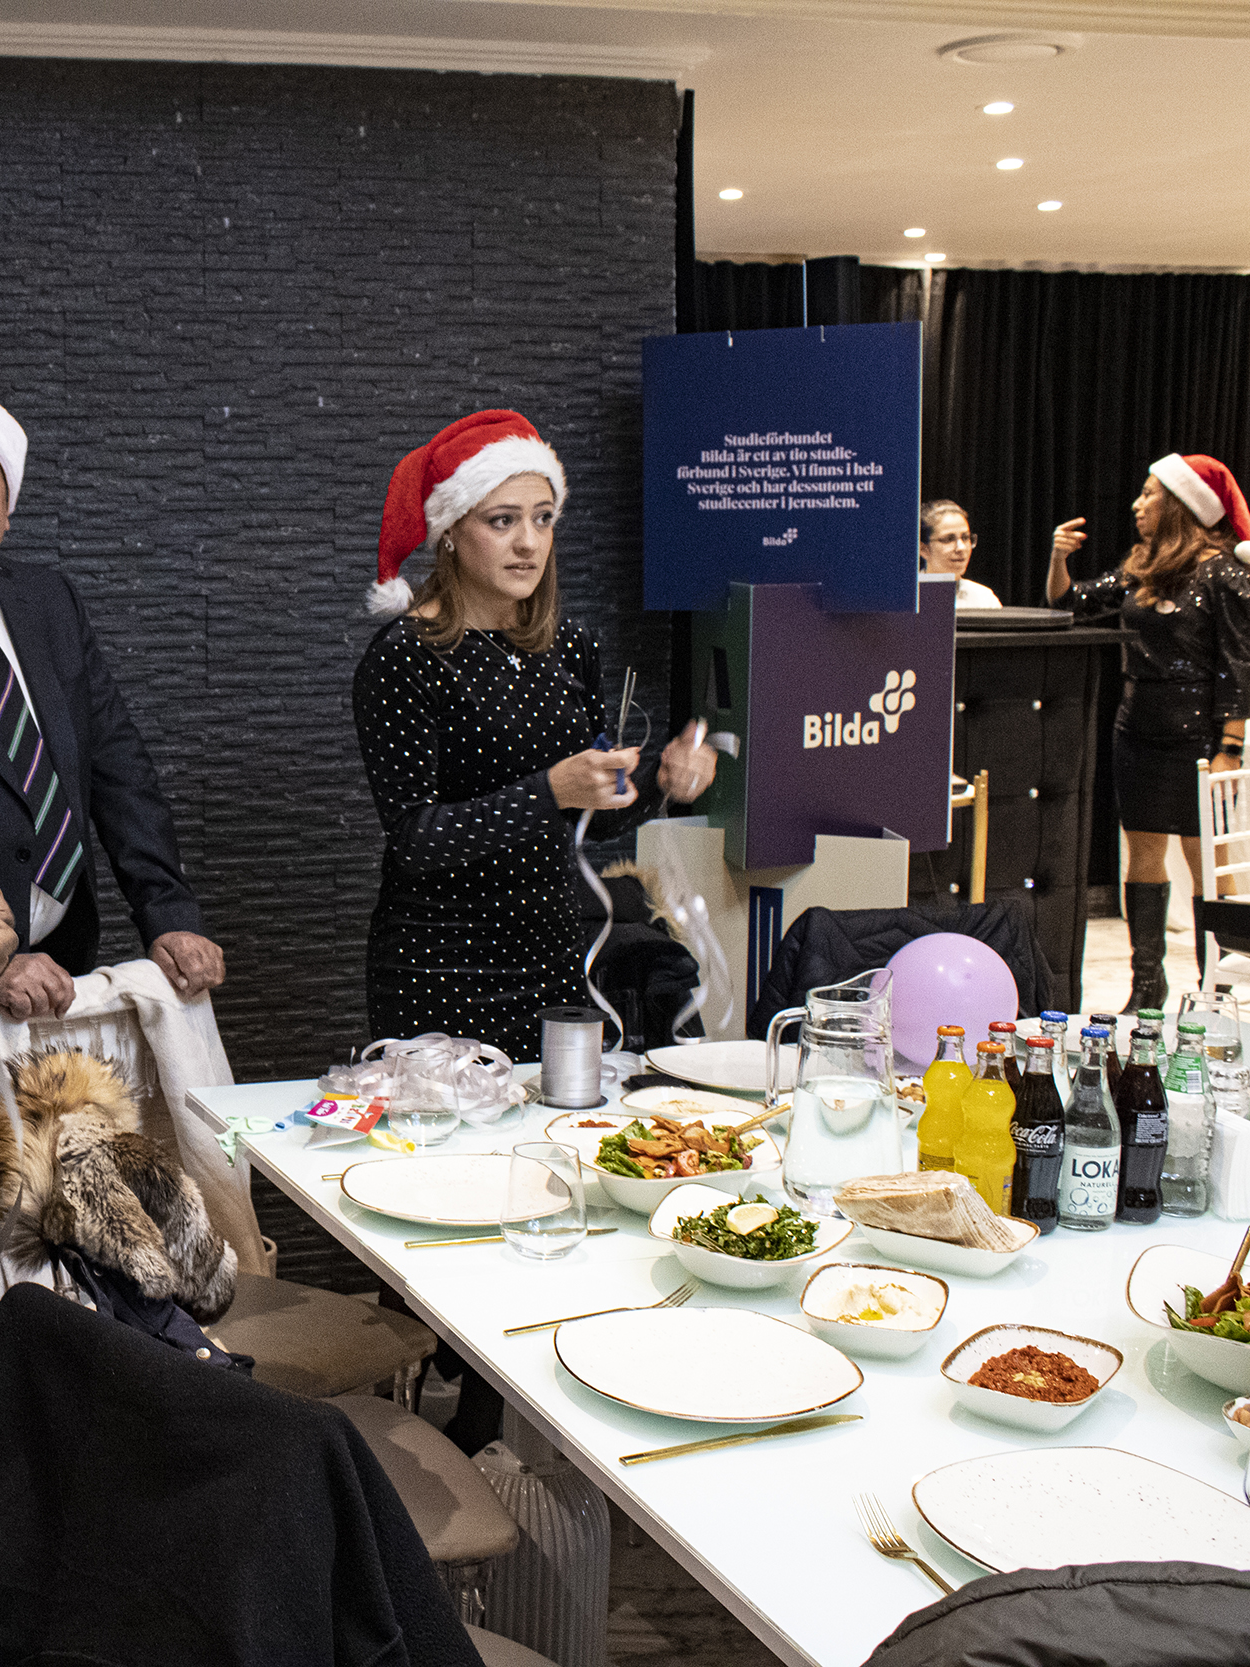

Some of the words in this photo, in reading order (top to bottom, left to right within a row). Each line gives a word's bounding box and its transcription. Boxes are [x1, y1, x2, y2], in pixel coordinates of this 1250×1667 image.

[724, 431, 832, 446] Studieförbundet
[701, 449, 735, 462] Bilda
[737, 448, 751, 462] är
[753, 449, 770, 461] ett
[772, 451, 788, 461] av
[789, 448, 807, 460] tio
[810, 446, 857, 460] studie-
[677, 465, 729, 479] förbund
[732, 466, 736, 478] i
[739, 465, 790, 479] Sverige.
[792, 464, 806, 476] Vi
[809, 464, 843, 476] finns
[846, 463, 850, 475] i
[854, 462, 883, 475] hela
[687, 481, 735, 496] Sverige
[737, 481, 760, 493] och
[763, 481, 787, 493] har
[788, 480, 854, 492] dessutom
[856, 480, 874, 491] ett
[698, 497, 779, 510] studiecenter
[781, 496, 785, 508] i
[788, 495, 860, 510] Jerusalem.
[763, 536, 787, 546] Bilda
[803, 711, 880, 749] Bilda
[1072, 1158, 1119, 1179] LOKA
